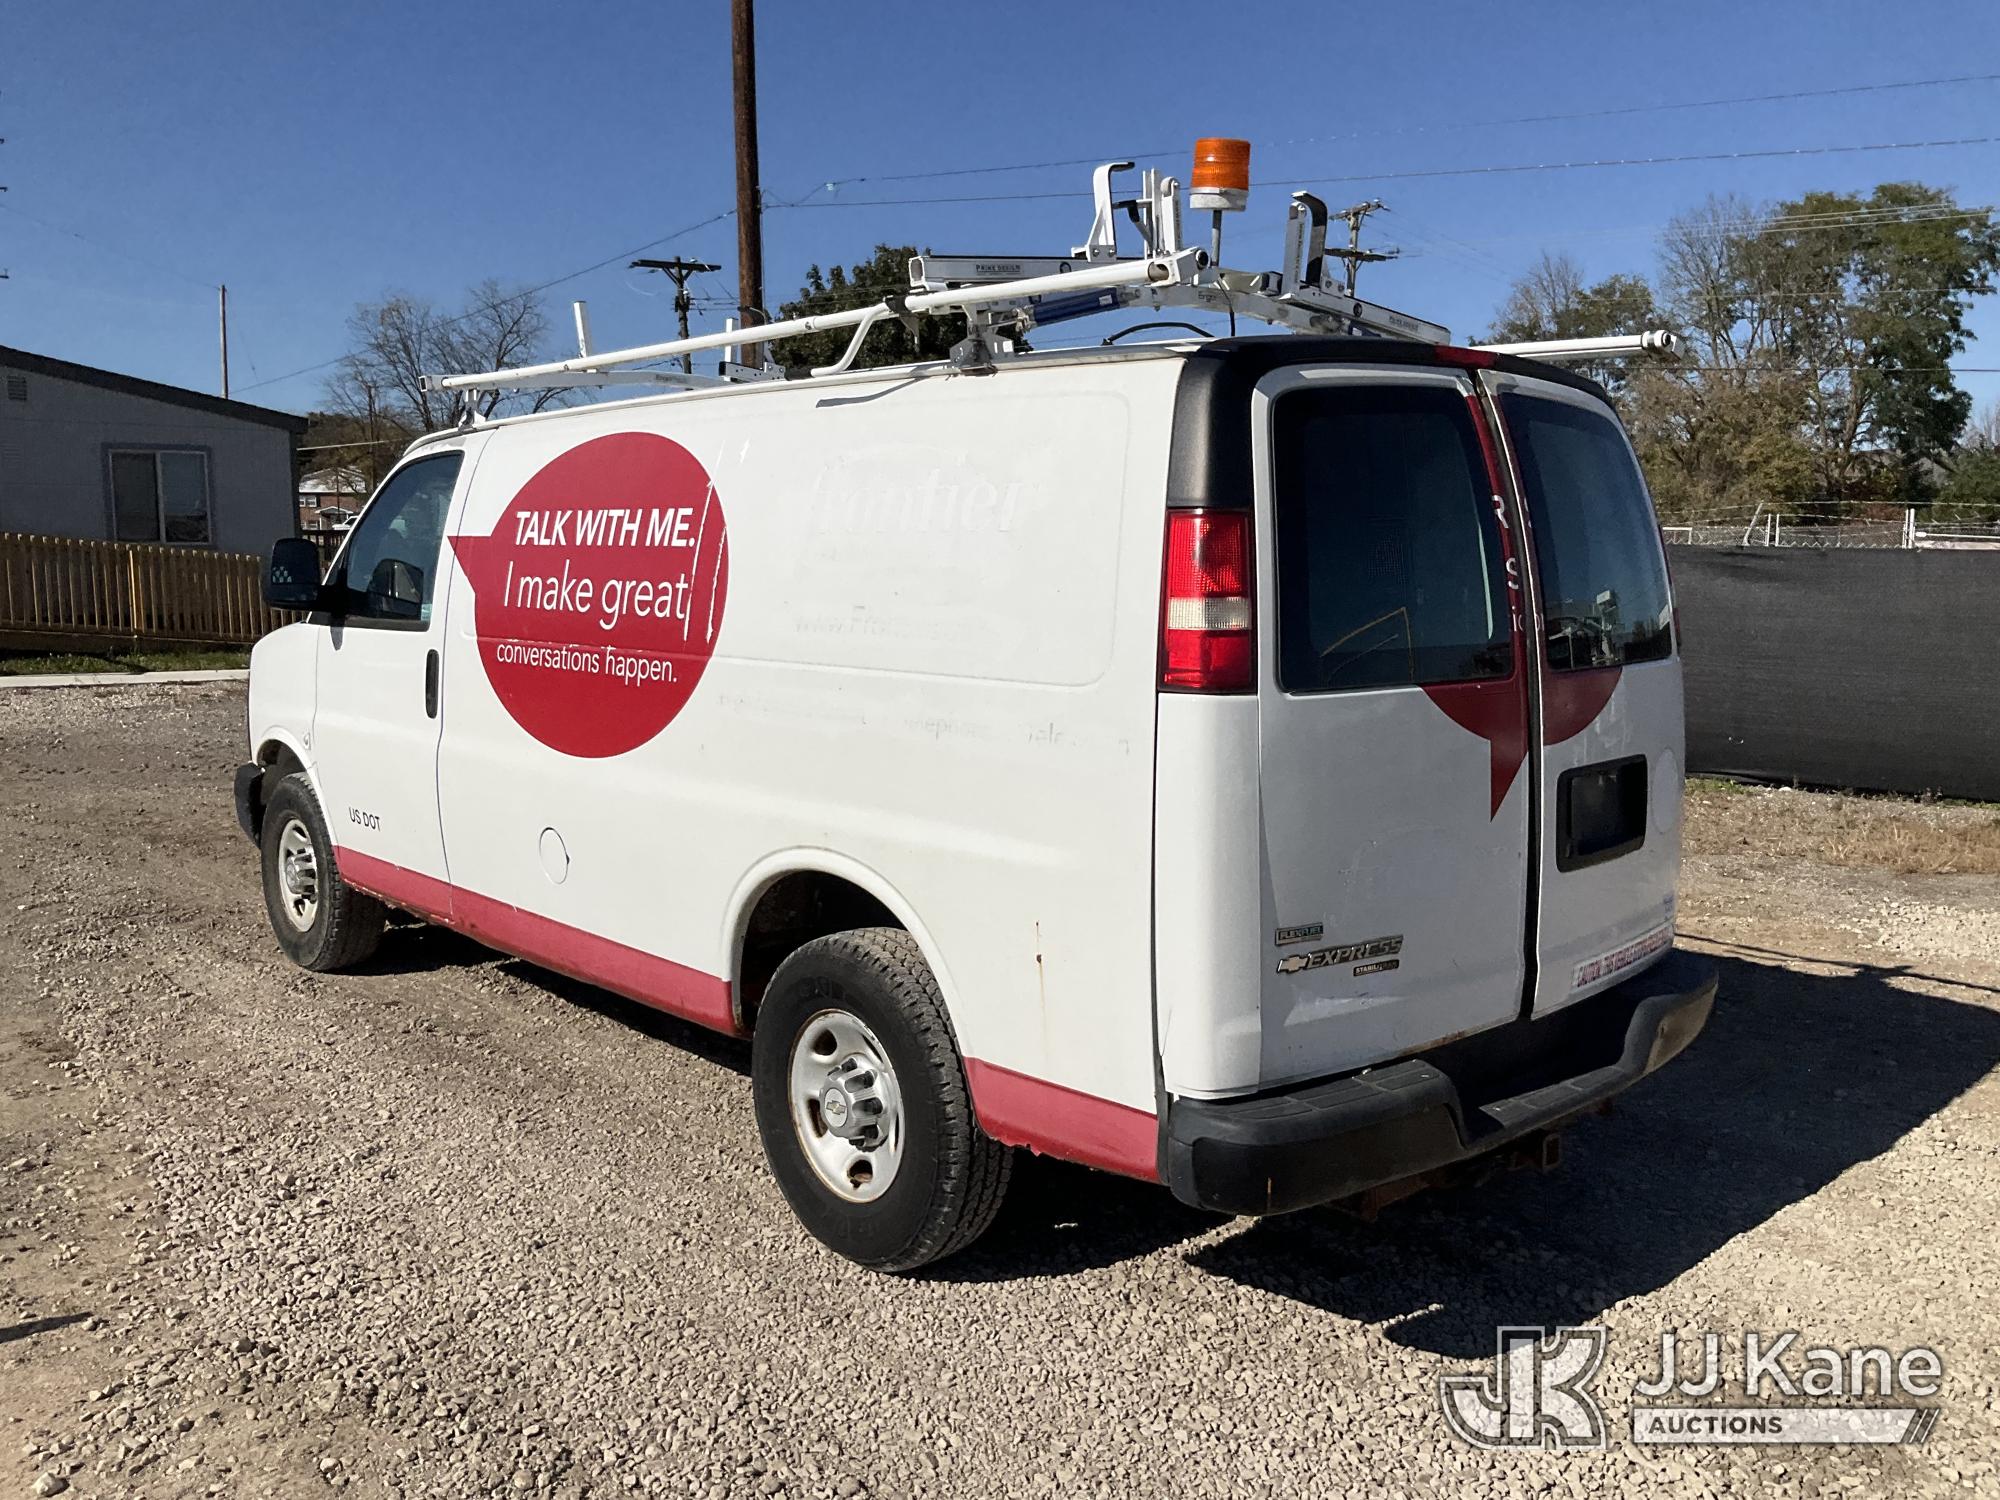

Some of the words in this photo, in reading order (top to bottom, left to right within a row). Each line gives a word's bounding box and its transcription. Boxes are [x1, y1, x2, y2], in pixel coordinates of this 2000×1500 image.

[515, 509, 573, 546] TALK
[575, 508, 643, 547] WITH
[645, 507, 695, 547] ME.
[503, 560, 514, 607] I
[517, 558, 594, 613] make
[599, 573, 689, 630] great
[496, 643, 600, 674] conversations
[605, 647, 678, 687] happen.
[348, 806, 362, 825] US
[362, 811, 381, 832] DOT
[1307, 937, 1403, 969] EXPRESS
